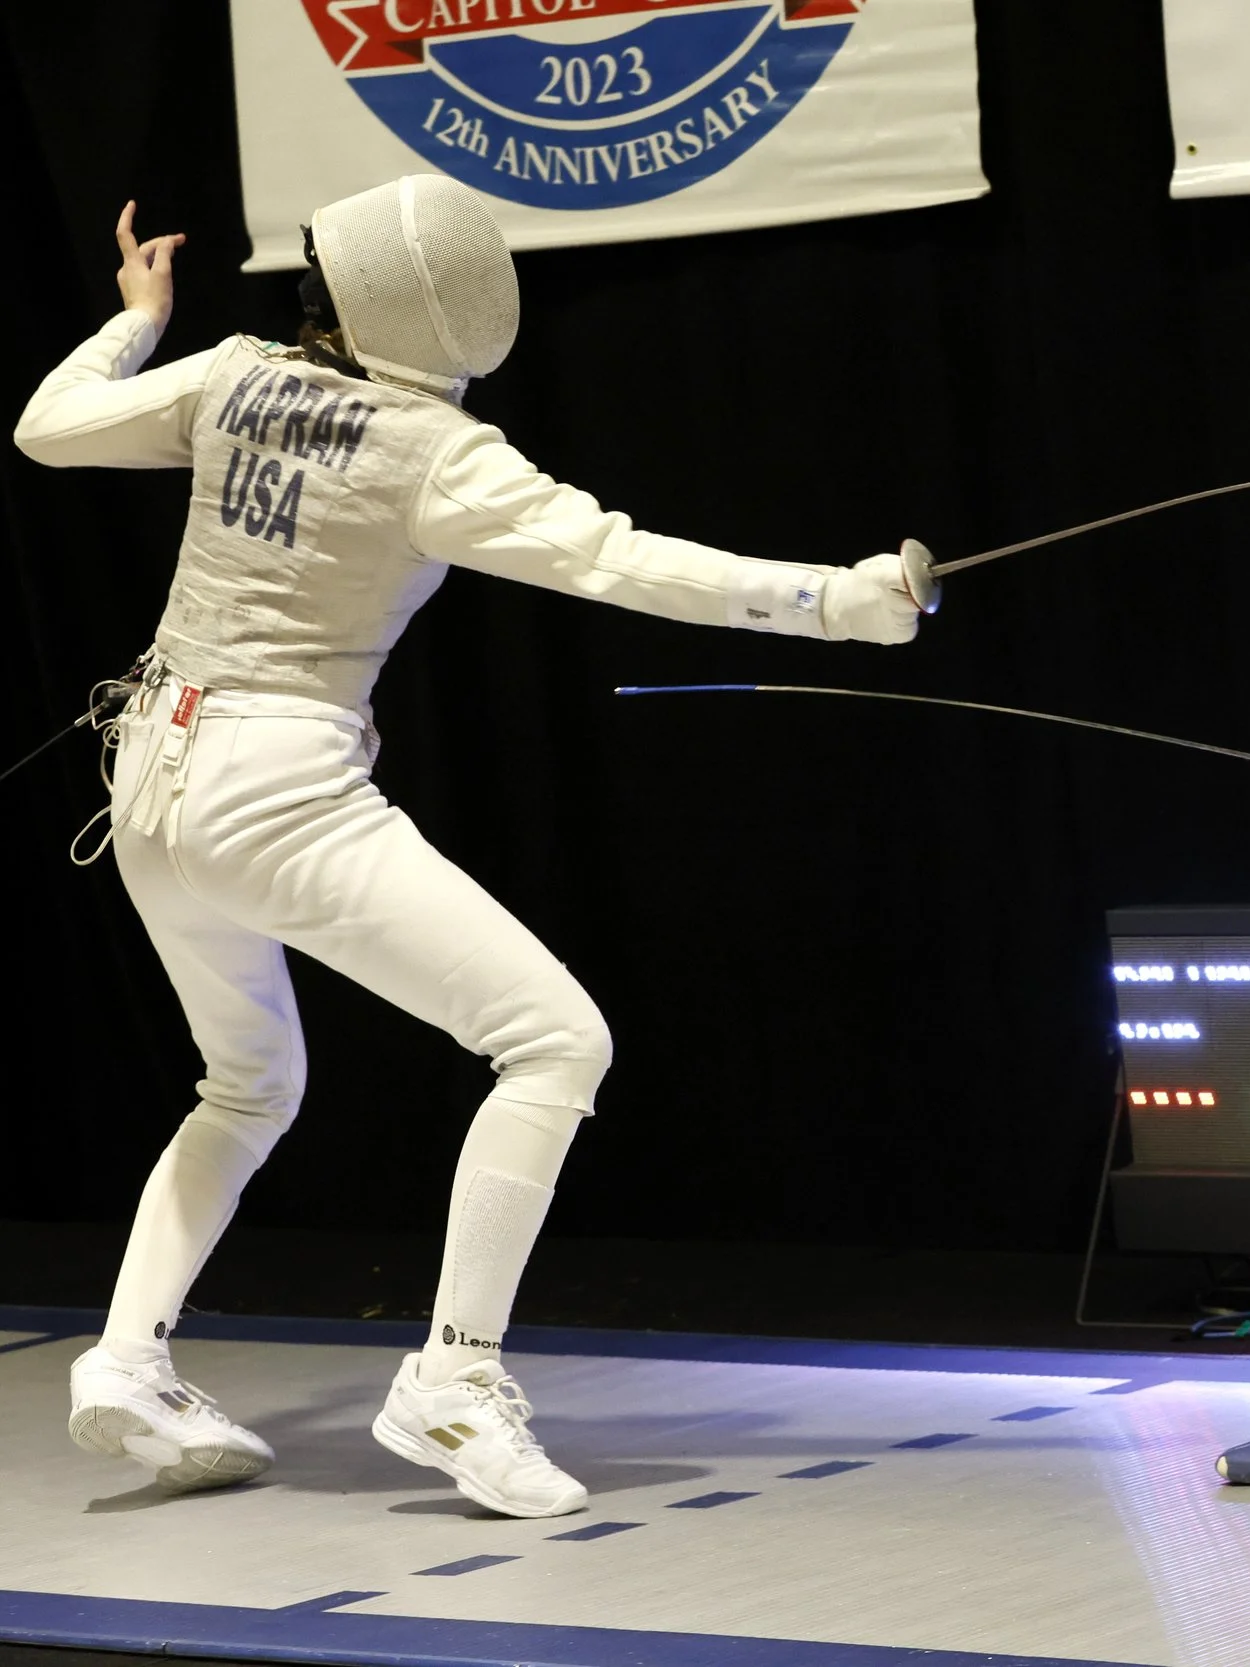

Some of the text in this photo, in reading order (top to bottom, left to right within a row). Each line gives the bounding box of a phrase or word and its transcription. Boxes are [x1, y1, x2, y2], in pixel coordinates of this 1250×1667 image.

[534, 46, 652, 106] 2023
[422, 58, 780, 185] 12th ANNIVERSARY
[221, 447, 304, 549] USA
[459, 1332, 501, 1349] Leon
